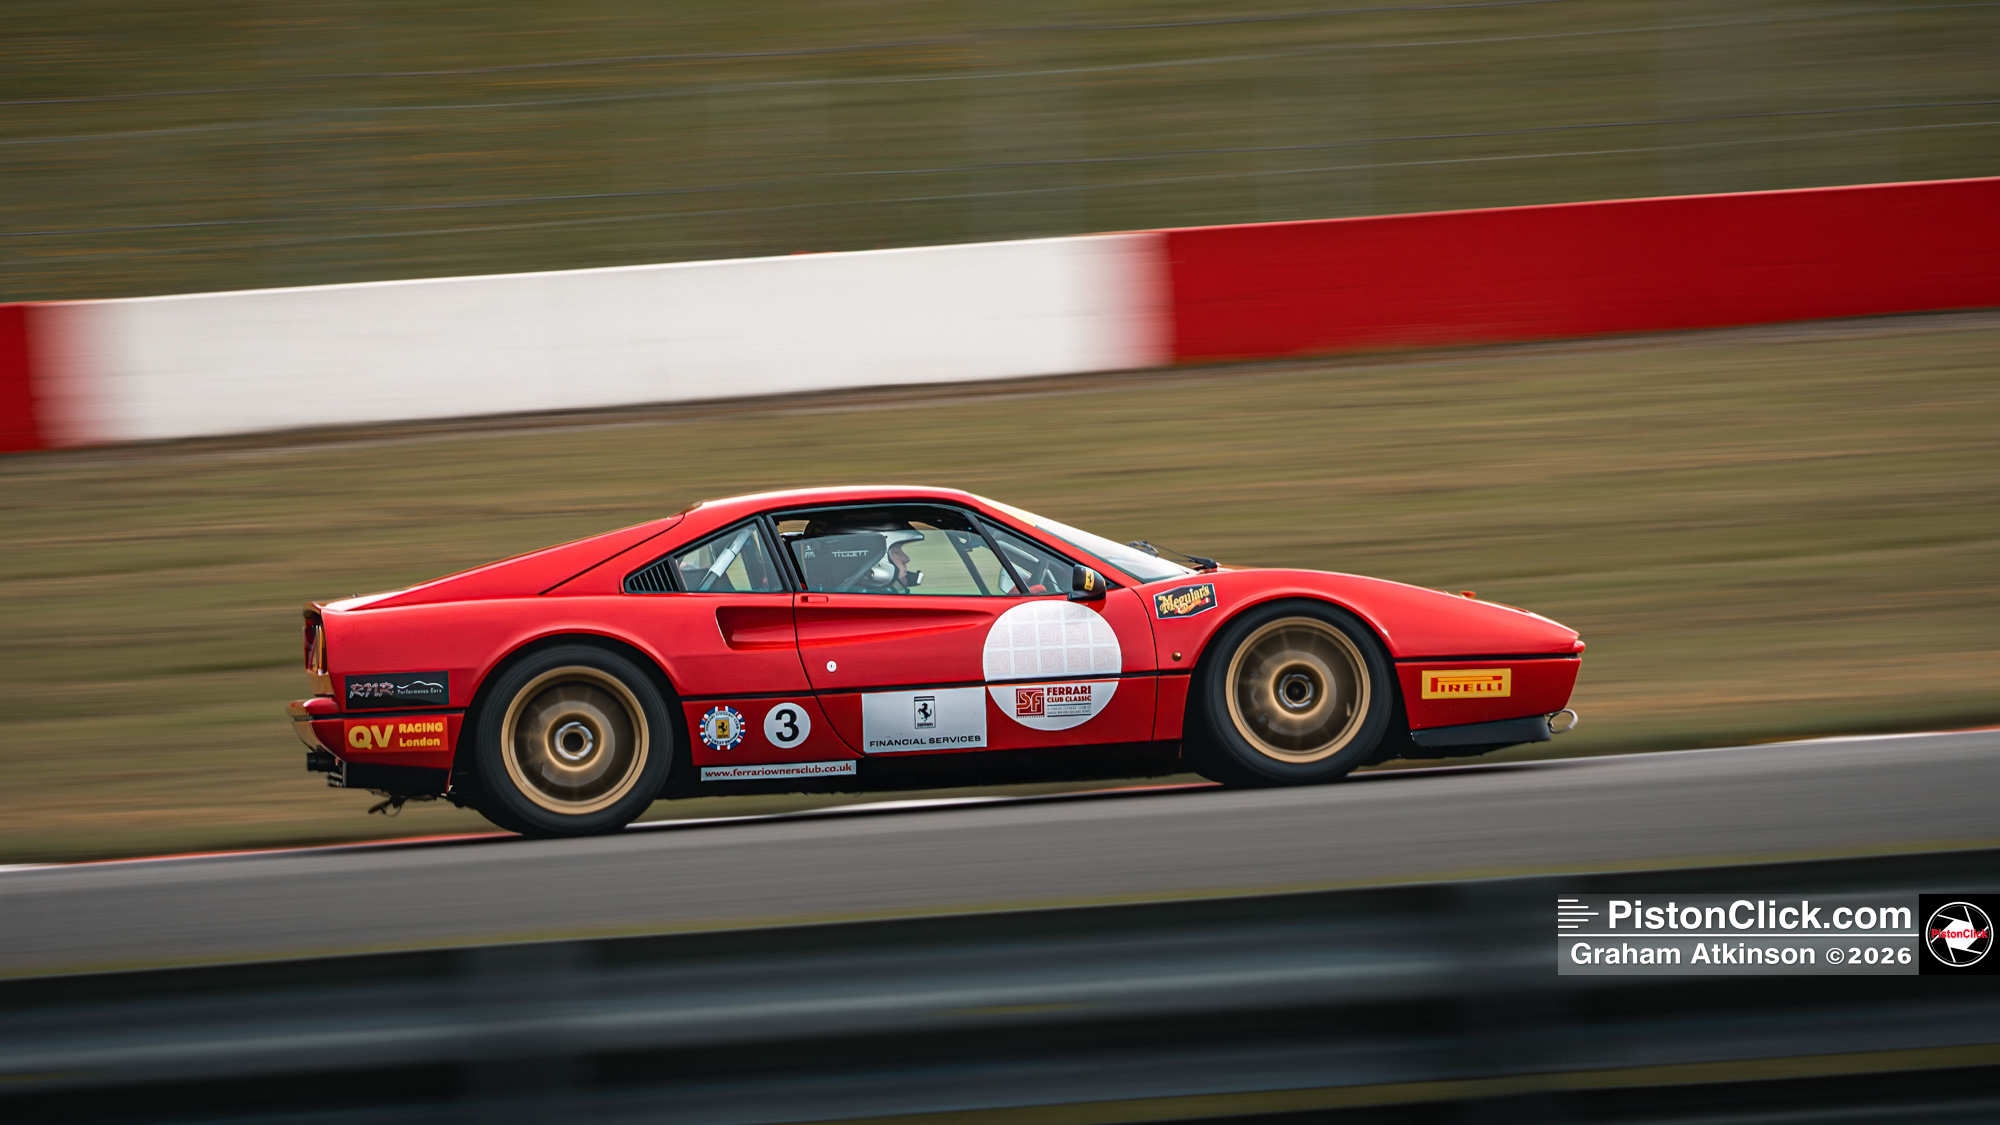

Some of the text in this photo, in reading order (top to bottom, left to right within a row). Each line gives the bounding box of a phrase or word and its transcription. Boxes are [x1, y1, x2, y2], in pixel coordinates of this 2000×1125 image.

[1047, 685, 1091, 696] FERRARI
[1430, 675, 1503, 693] PIRELLI
[399, 722, 443, 733] RACING
[775, 709, 799, 742] 3
[349, 724, 394, 750] QV
[400, 737, 440, 747] London
[870, 735, 981, 747] FINANCIAL SERVICES
[705, 763, 852, 777] www.ferrariownersclub.co.uk
